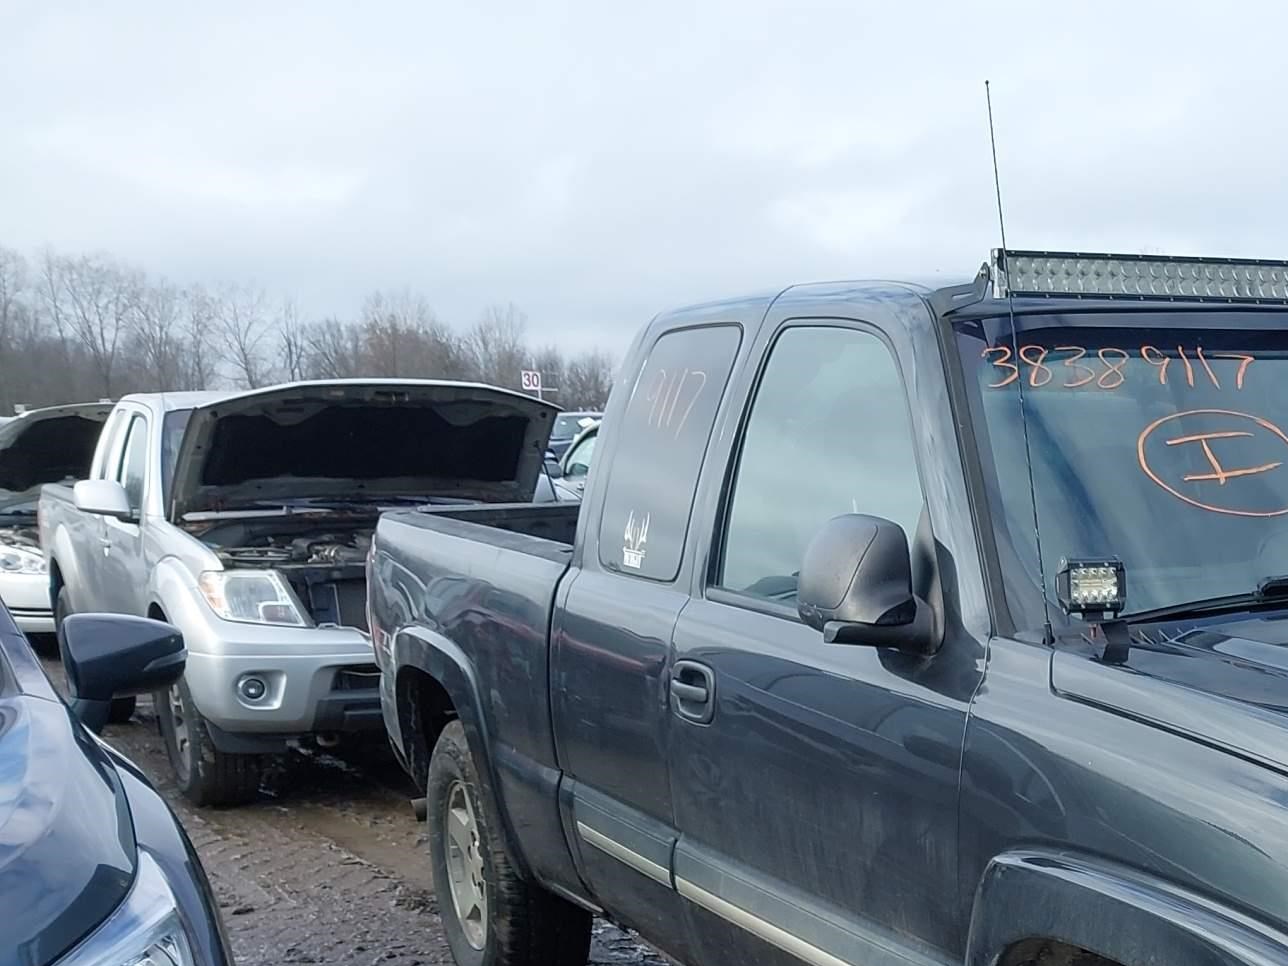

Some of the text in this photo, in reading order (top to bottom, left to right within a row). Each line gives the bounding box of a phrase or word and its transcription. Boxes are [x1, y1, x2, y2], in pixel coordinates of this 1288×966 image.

[523, 372, 540, 388] 30
[980, 345, 1256, 391] 38389117
[647, 367, 707, 441] 9117
